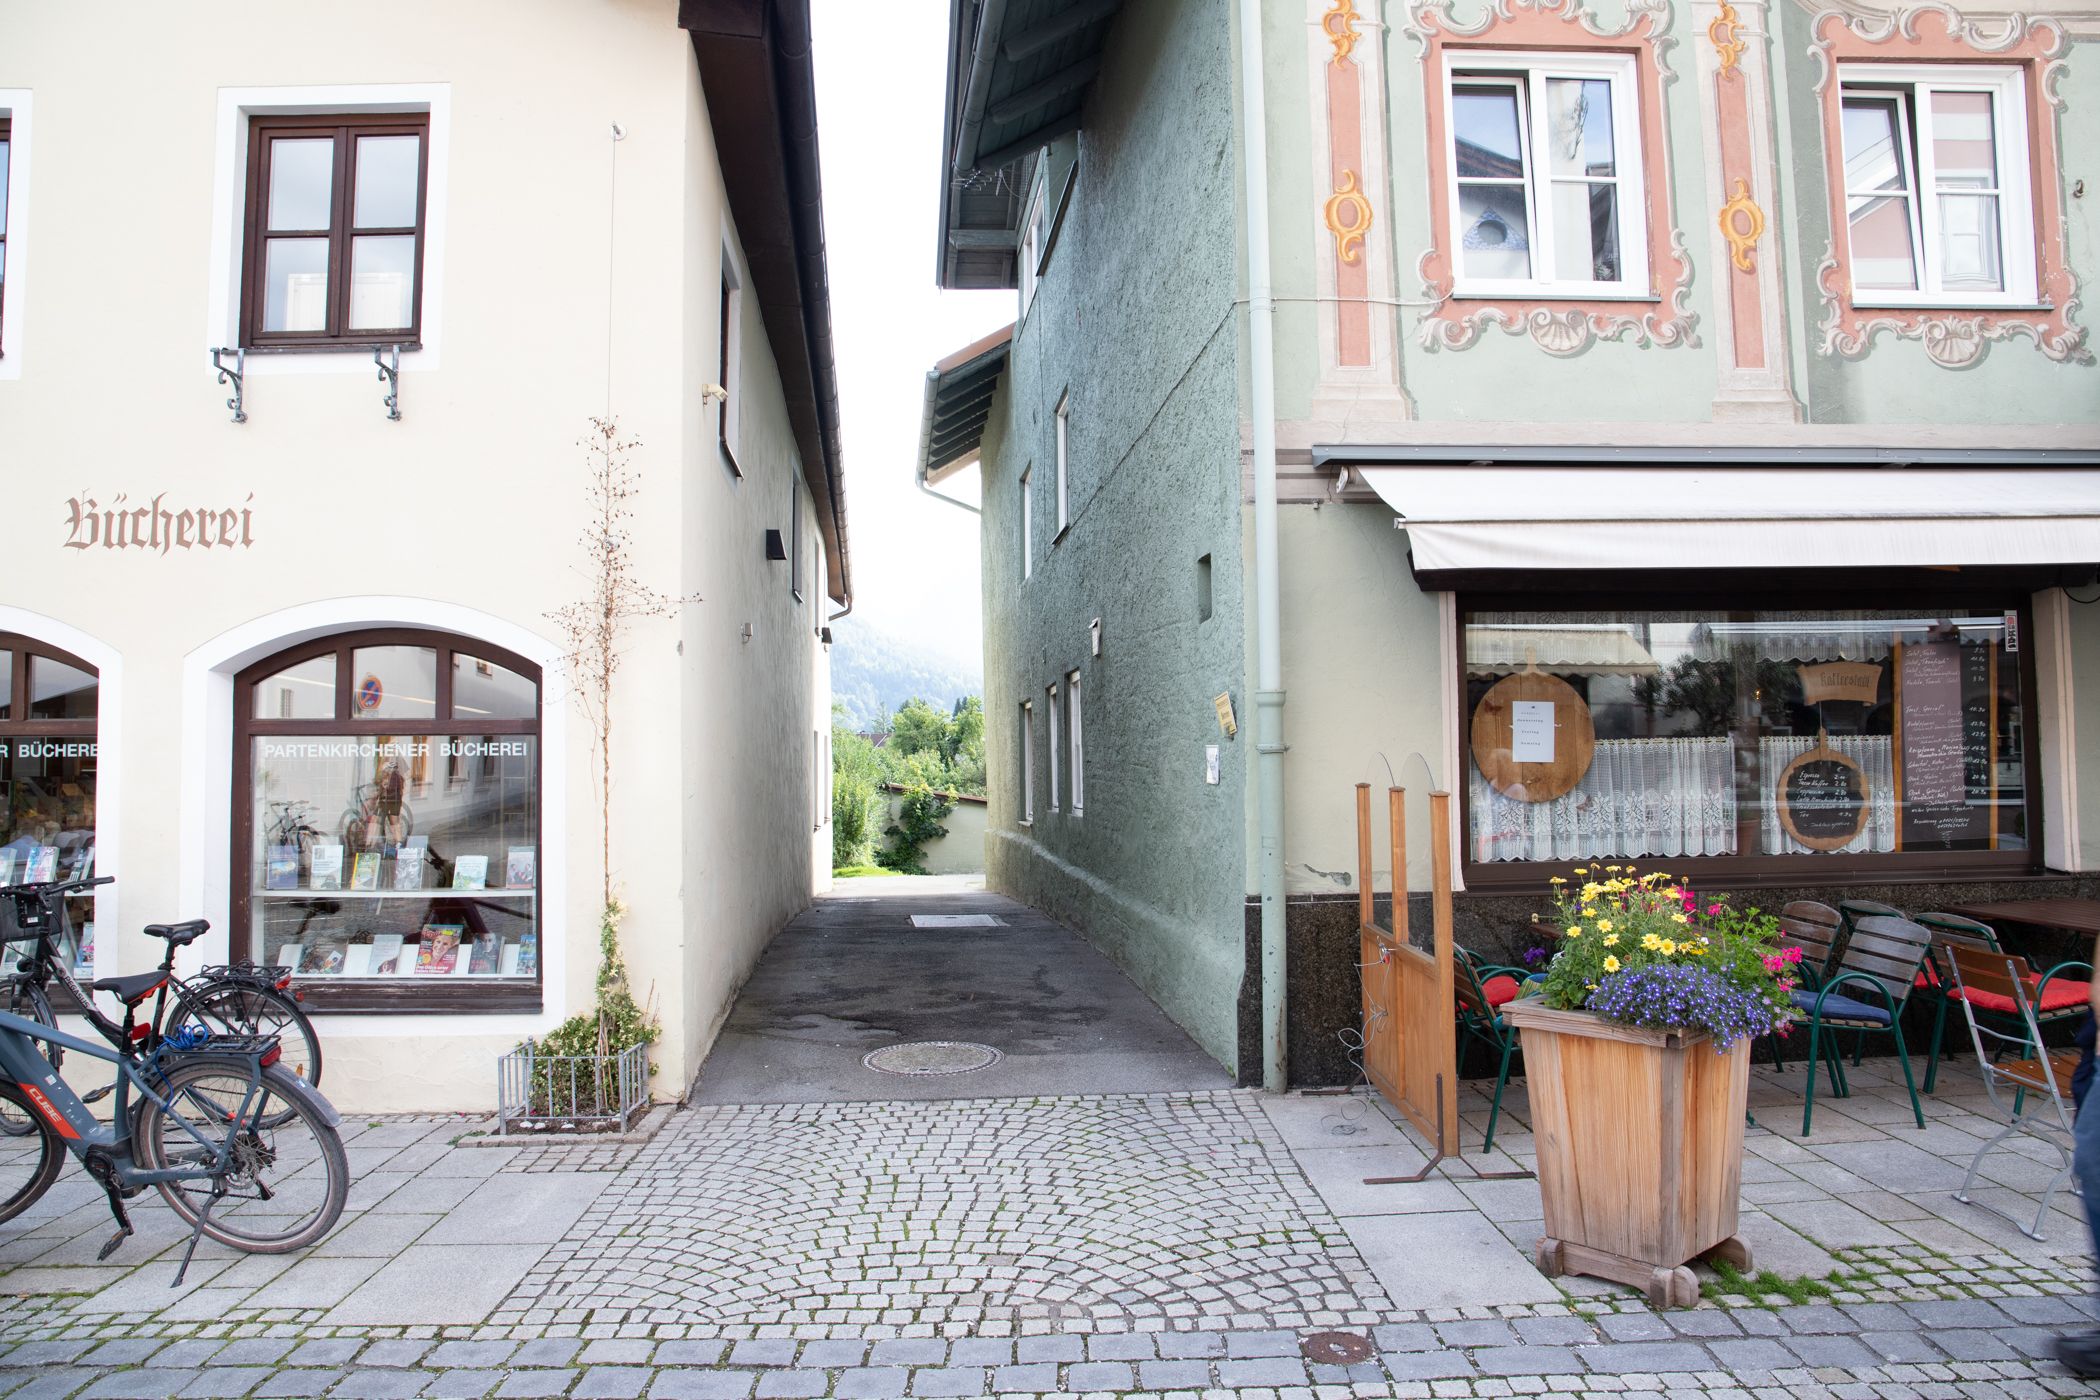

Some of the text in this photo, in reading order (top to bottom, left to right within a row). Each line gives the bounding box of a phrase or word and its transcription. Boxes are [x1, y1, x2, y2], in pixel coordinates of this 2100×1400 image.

[63, 488, 255, 557] Bücherei
[264, 740, 527, 758] PARTENKIRCHENER BÜCHEREI
[65, 976, 90, 1008] PEGASUS
[29, 1087, 62, 1123] CUBE
